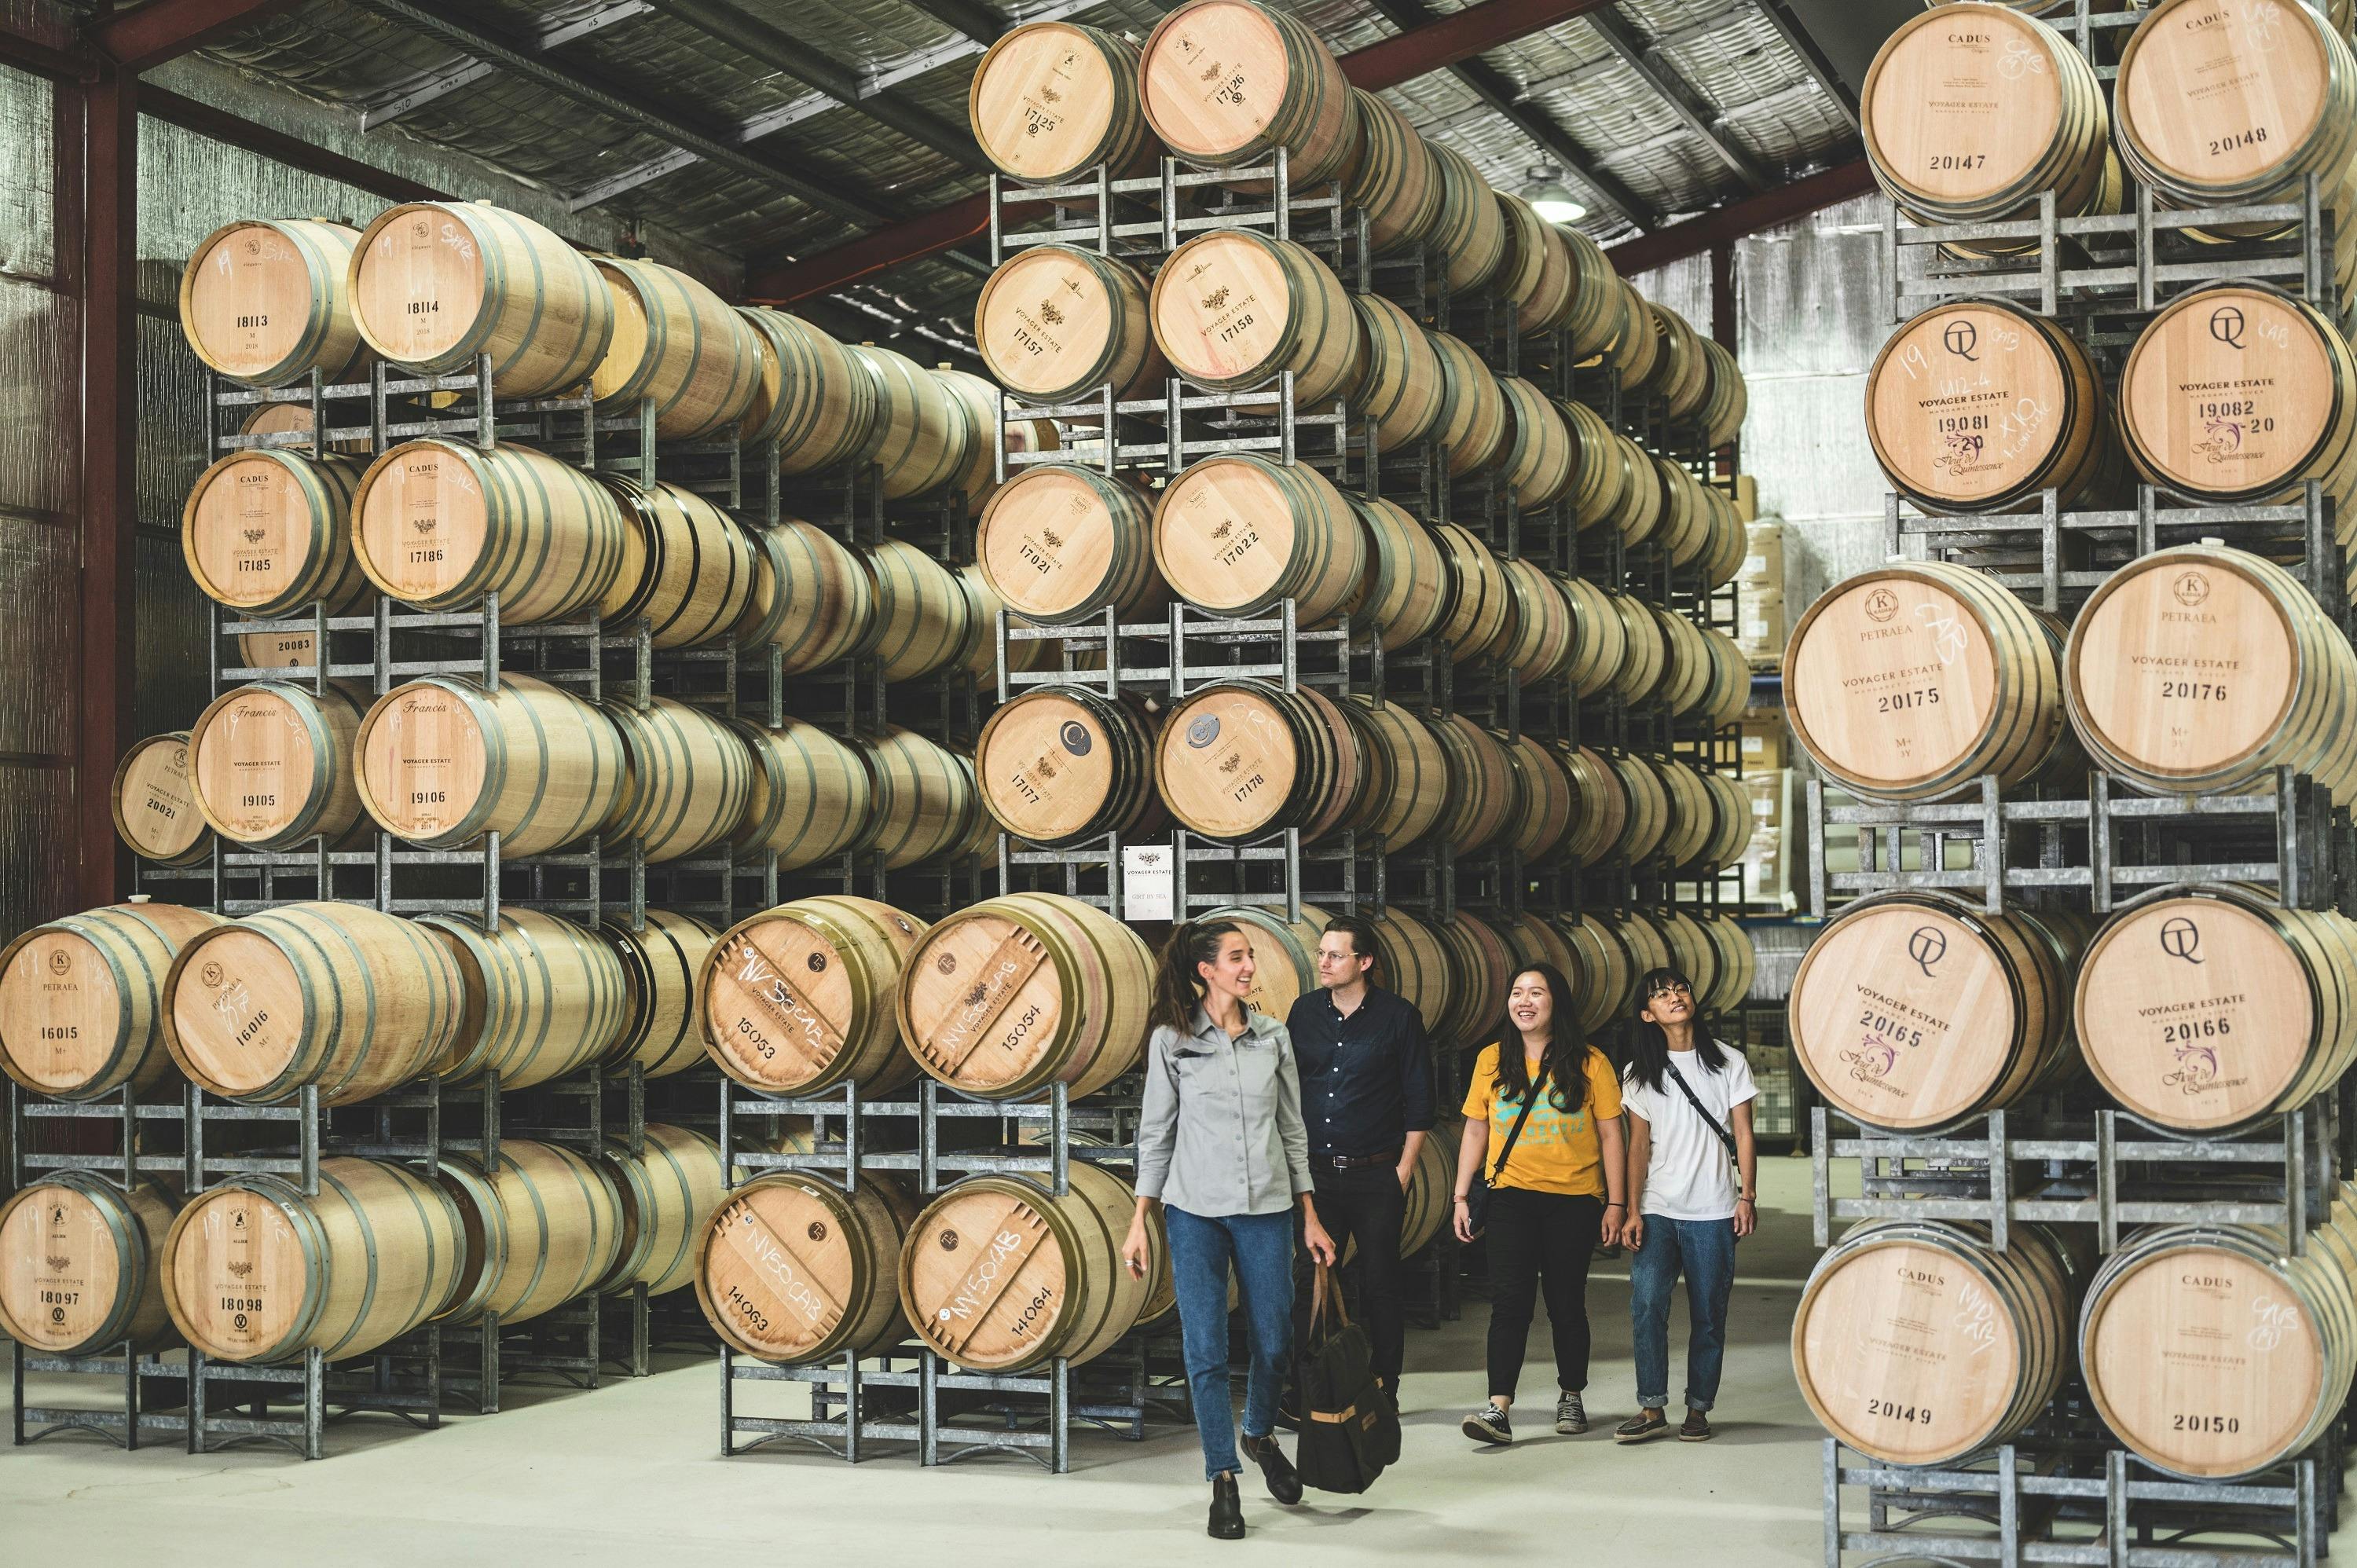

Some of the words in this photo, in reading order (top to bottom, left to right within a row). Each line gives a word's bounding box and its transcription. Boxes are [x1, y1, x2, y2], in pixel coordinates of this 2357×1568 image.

[2186, 10, 2230, 29] CADUS
[1948, 34, 1991, 43] CADUS
[1203, 80, 1224, 103] VOYAGER
[1224, 62, 1243, 81] ESTATE
[1215, 74, 1245, 104] 17126
[2187, 82, 2226, 98] VOYAGER
[2229, 71, 2260, 85] ESTATE
[1023, 94, 1046, 112] VOYAGER
[1047, 108, 1065, 124] ESTATE
[1025, 107, 1055, 132] 17125
[2209, 127, 2267, 156] 20148
[1930, 155, 1986, 170] 20147
[408, 300, 439, 314] 18114
[1200, 313, 1230, 337] VOYAGER
[1231, 294, 1256, 314] ESTATE
[237, 315, 268, 328] 18113
[1015, 307, 1042, 332] VOYAGER
[1041, 331, 1062, 354] ESTATE
[1221, 314, 1254, 343] 17158
[1014, 328, 1043, 356] 17157
[1900, 343, 1928, 379] 19
[2179, 381, 2231, 392] VOYAGER
[2234, 378, 2275, 388] ESTATE
[1919, 396, 1967, 408] VOYAGER
[1970, 391, 2010, 403] ESTATE
[2200, 401, 2254, 418] 19082
[1929, 405, 1971, 415] MARGARET
[1938, 415, 1989, 432] 19081
[2191, 437, 2223, 454] Fleur
[2223, 441, 2234, 451] de
[1934, 451, 1963, 468] Fleur
[1965, 453, 1976, 464] de
[2207, 451, 2266, 464] Quintessence
[409, 463, 439, 473] CADUS
[1949, 462, 2003, 477] Quintessence
[240, 474, 269, 483] CADUS
[1073, 496, 1088, 511] Saury
[1189, 490, 1204, 505] Saury
[1212, 539, 1235, 561] VOYAGER
[1235, 521, 1253, 540] ESTATE
[1223, 531, 1259, 566] 17022
[410, 550, 443, 563] 17186
[1020, 544, 1051, 574] 17021
[1024, 533, 1046, 554] VOYAGER
[1045, 552, 1064, 570] ESTATE
[239, 559, 271, 572] 17185
[2161, 611, 2217, 624] PETRAEA
[1860, 625, 1913, 642] PETRAEA
[278, 639, 310, 651] 20083
[2132, 656, 2188, 667] VOYAGER
[2194, 659, 2240, 670] ESTATE
[1842, 672, 1896, 688] VOYAGER
[1901, 663, 1944, 678] ESTATE
[1878, 687, 1940, 713] 20175
[2162, 681, 2227, 702] 20176
[146, 782, 170, 800] VOYAGER
[170, 794, 189, 808] ESTATE
[412, 791, 445, 805] 19106
[1012, 775, 1039, 804] 17177
[1234, 774, 1264, 802] 17178
[147, 798, 176, 819] 20021
[243, 793, 276, 807] 19105
[42, 983, 79, 991] PETRAEA
[752, 986, 775, 1013] VOYAGER
[775, 1010, 795, 1034] ESTATE
[970, 1005, 994, 1033] VOYAGER
[992, 982, 1013, 1006] ESTATE
[1856, 984, 1908, 1013] VOYAGER
[1910, 1009, 1952, 1032] ESTATE
[2139, 1002, 2196, 1017] VOYAGER
[2201, 994, 2246, 1009] ESTATE
[42, 1027, 78, 1040] 16015
[236, 1010, 269, 1046] 16016
[1003, 1005, 1041, 1051] 15054
[1860, 1009, 1923, 1048] 20165
[2164, 1017, 2231, 1043] 20166
[738, 1017, 775, 1060] 15053
[1839, 1050, 1871, 1069] Fleur
[1871, 1064, 1883, 1075] de
[1849, 1068, 1909, 1098] Quintessence
[2162, 1067, 2198, 1086] Fleur
[2183, 1077, 2249, 1096] Quintessence
[62, 1278, 84, 1287] ESTATE
[1897, 1267, 1946, 1286] CADUS
[2182, 1275, 2233, 1288] CADUS
[41, 1290, 79, 1306] 18097
[244, 1284, 267, 1292] ESTATE
[222, 1297, 262, 1312] 18098
[728, 1285, 768, 1331] 14063
[1012, 1287, 1052, 1336] 14064
[1869, 1337, 1911, 1353] VOYAGER
[1913, 1346, 1948, 1361] ESTATE
[2162, 1350, 2208, 1361] VOYAGER
[2210, 1356, 2247, 1366] ESTATE
[1868, 1398, 1933, 1426] 20149
[2173, 1414, 2240, 1434] 20150
